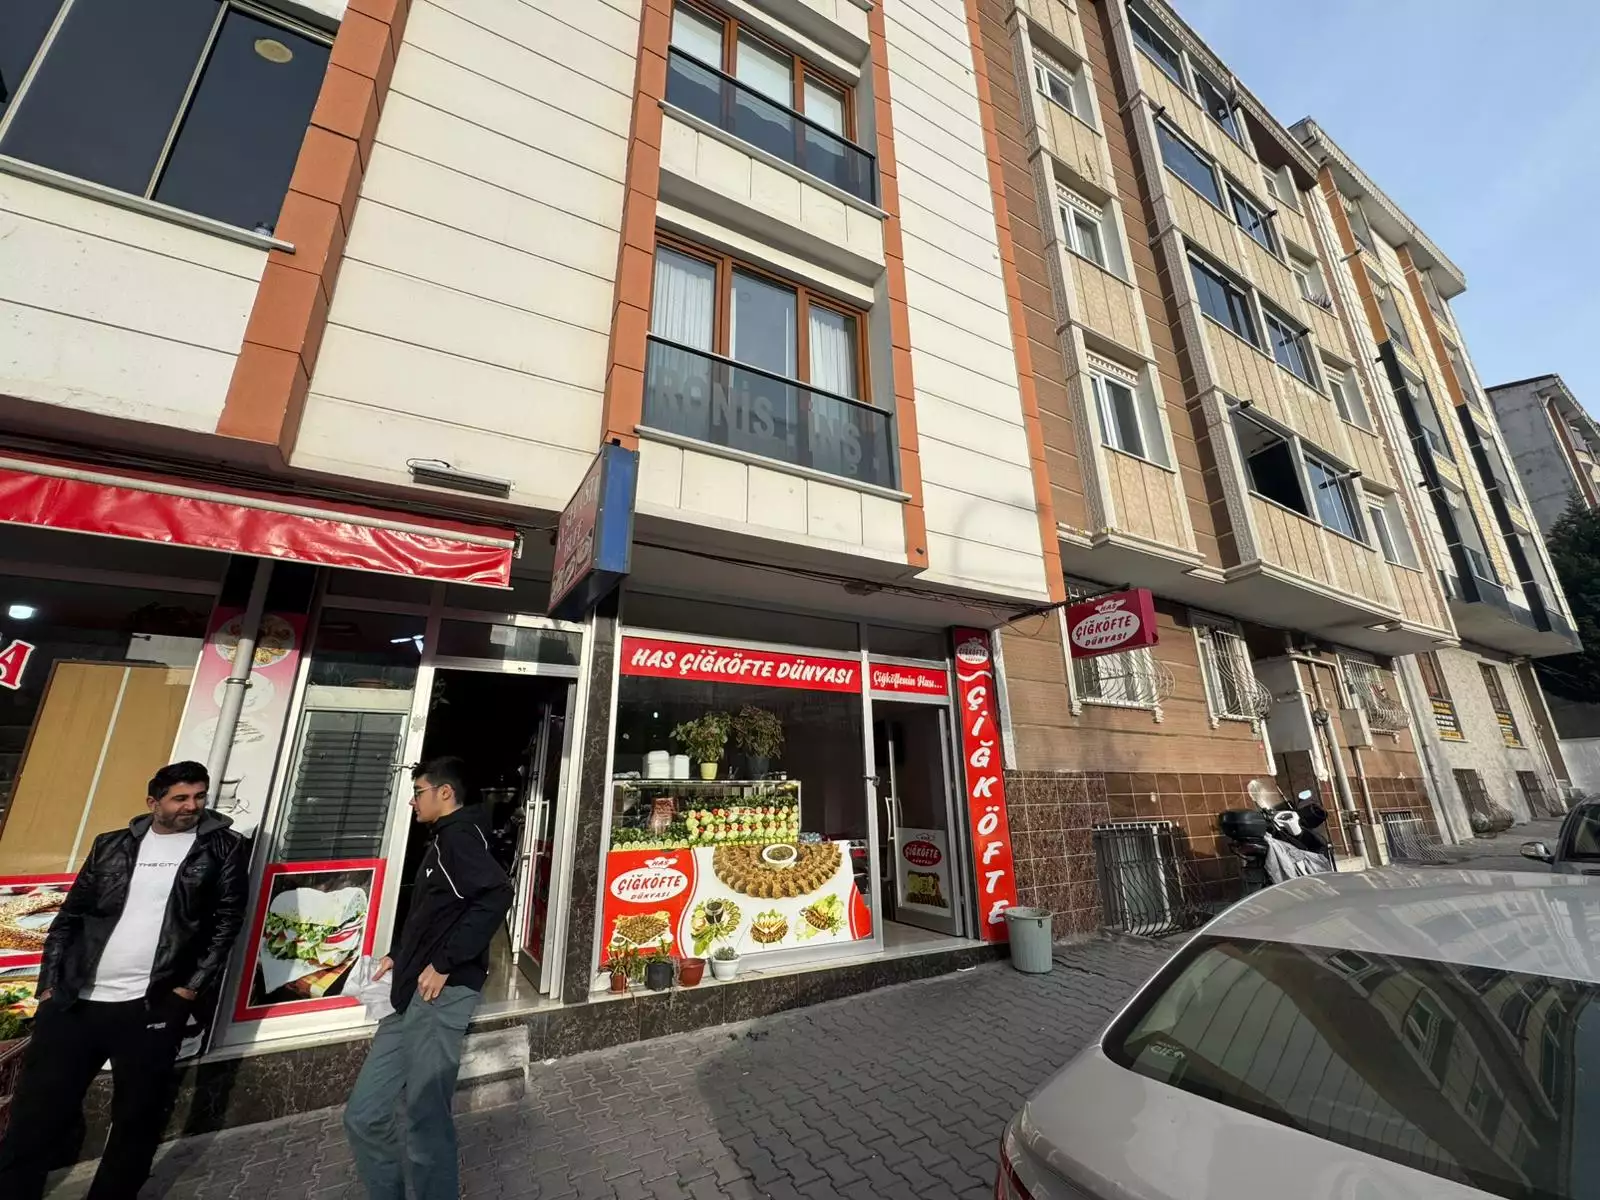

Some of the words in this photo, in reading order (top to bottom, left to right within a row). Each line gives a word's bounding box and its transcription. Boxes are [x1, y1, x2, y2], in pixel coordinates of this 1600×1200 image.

[1100, 602, 1117, 612] HAS
[1075, 615, 1132, 640] ÇİĞKÖFTE
[1085, 632, 1127, 647] DÜNYASI
[631, 648, 677, 669] HAS
[679, 649, 774, 677] ÇİĞKÖFTE
[776, 659, 854, 685] DÜNYASI
[966, 686, 1010, 925] ÇİĞKÖFTE
[651, 859, 670, 867] HAS
[617, 873, 682, 894] ÇİĞKÖFTE
[630, 891, 671, 900] DÜNYASI
